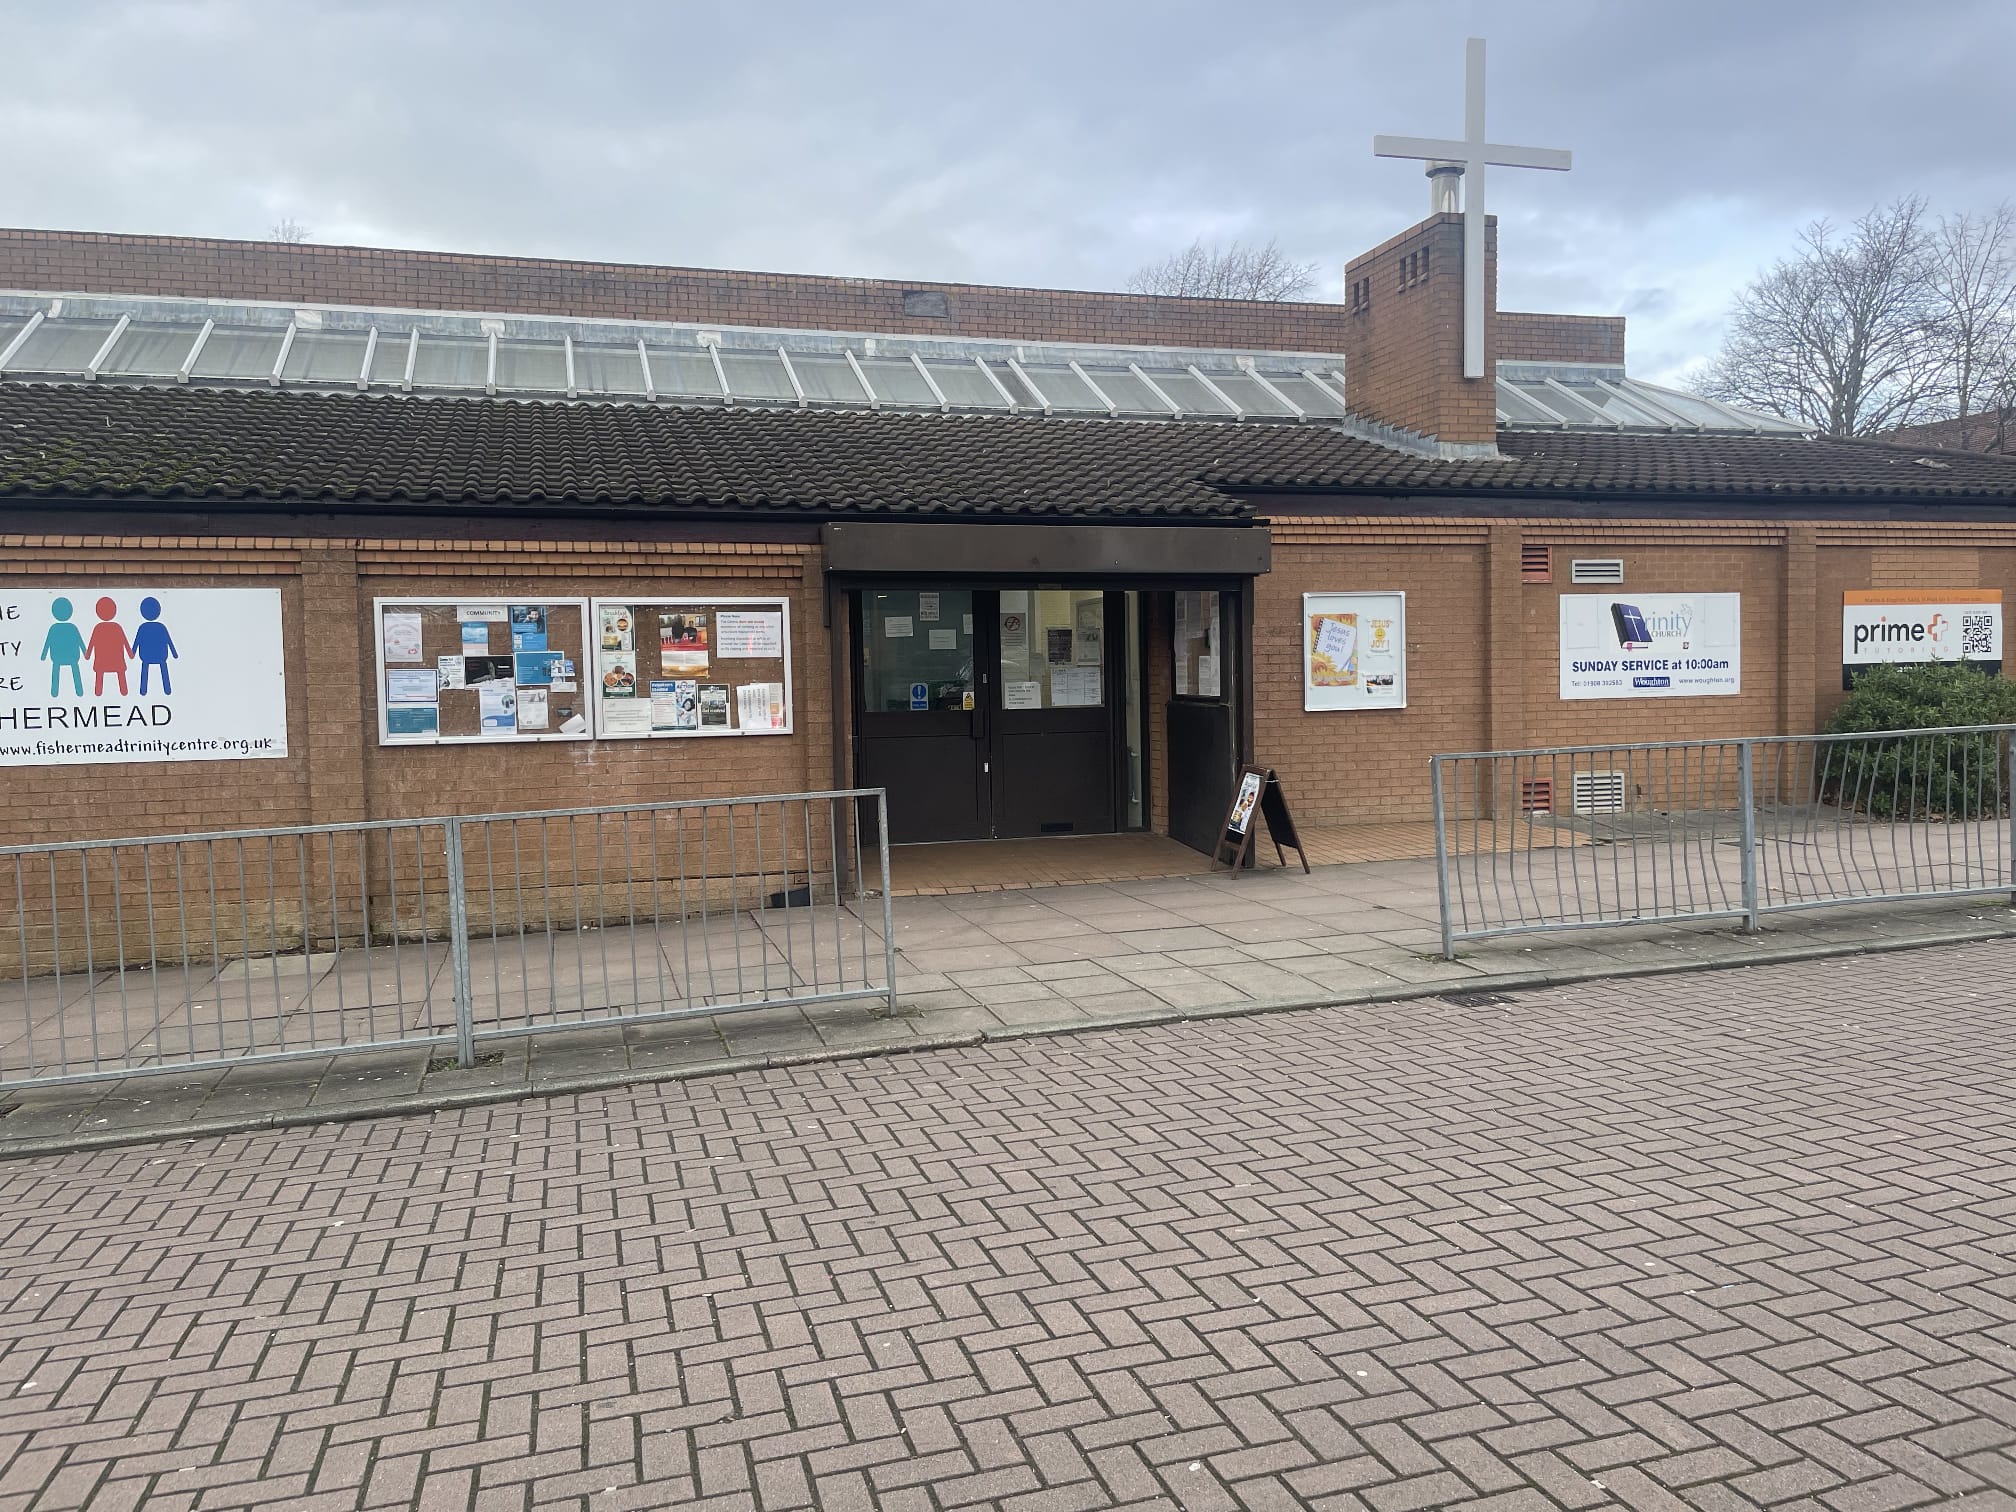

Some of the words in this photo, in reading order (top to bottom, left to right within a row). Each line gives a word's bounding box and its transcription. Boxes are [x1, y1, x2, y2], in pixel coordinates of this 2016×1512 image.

[466, 609, 501, 617] COMMUNITY
[1327, 623, 1350, 636] Jesus
[1371, 620, 1389, 628] JESUS
[1651, 630, 1682, 638] CHURCH
[1854, 616, 1925, 654] prime
[1327, 635, 1346, 646] loves
[1572, 660, 1618, 672] SUNDAY
[1621, 659, 1669, 672] SERVICE
[1671, 659, 1682, 670] at
[1685, 658, 1729, 670] 10:00am
[0, 737, 272, 756] www.fishermeadtrinitycentre.org.uk
